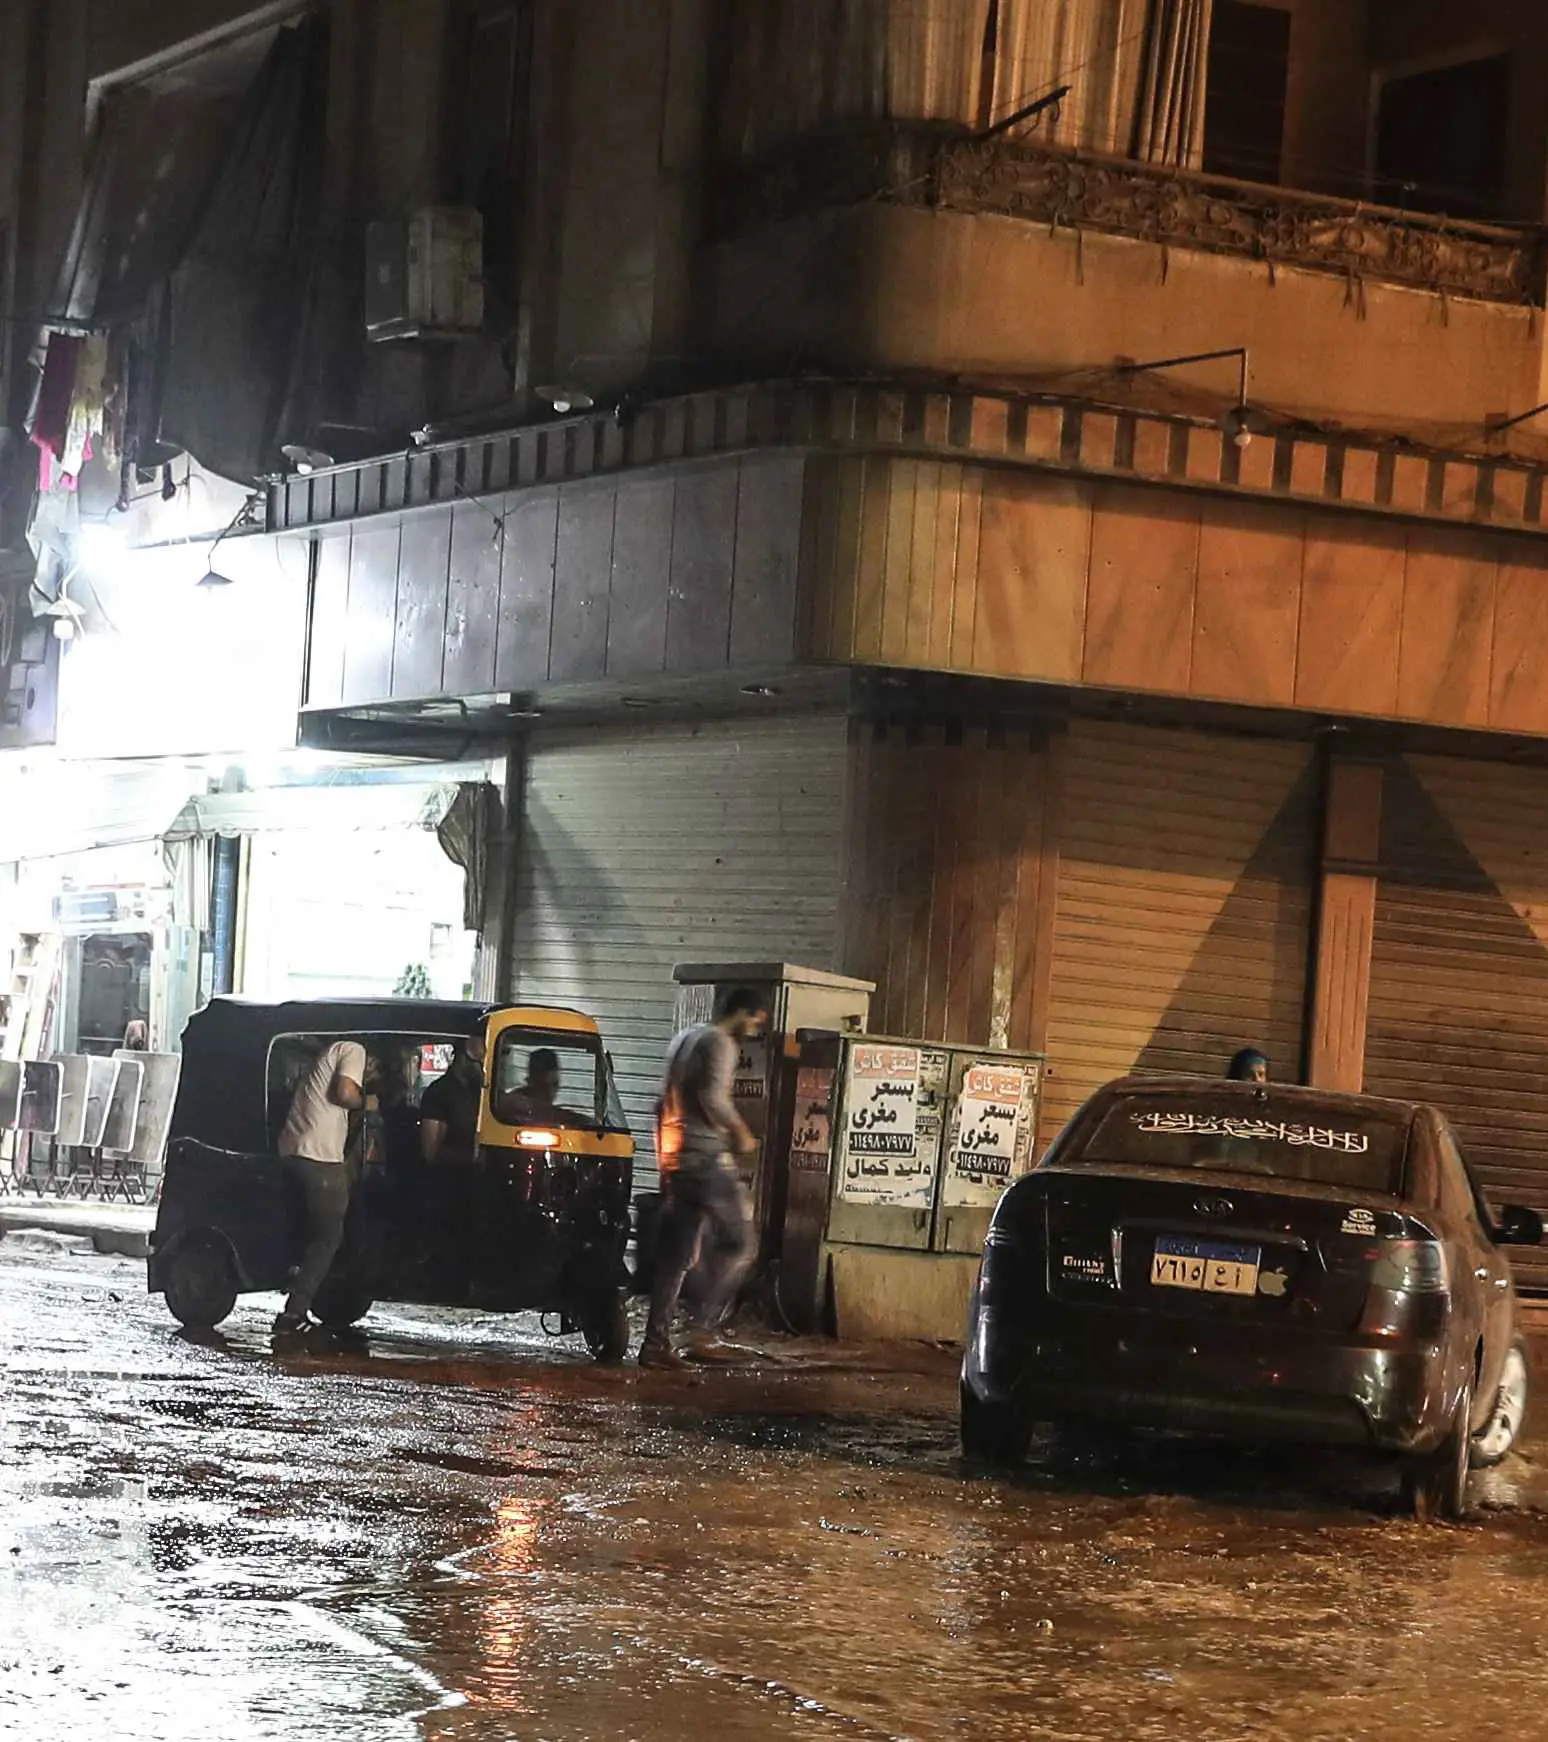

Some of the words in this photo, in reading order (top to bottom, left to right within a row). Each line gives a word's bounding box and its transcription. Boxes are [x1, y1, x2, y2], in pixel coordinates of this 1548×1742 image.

[870, 1082, 915, 1103] بسعر
[979, 1104, 1017, 1127] بسعر
[849, 1133, 913, 1151] ٠١١٤٩٨٠٧٩٧٧
[847, 1158, 889, 1179] كمال
[1155, 1258, 1201, 1281] ٧٦١٥
